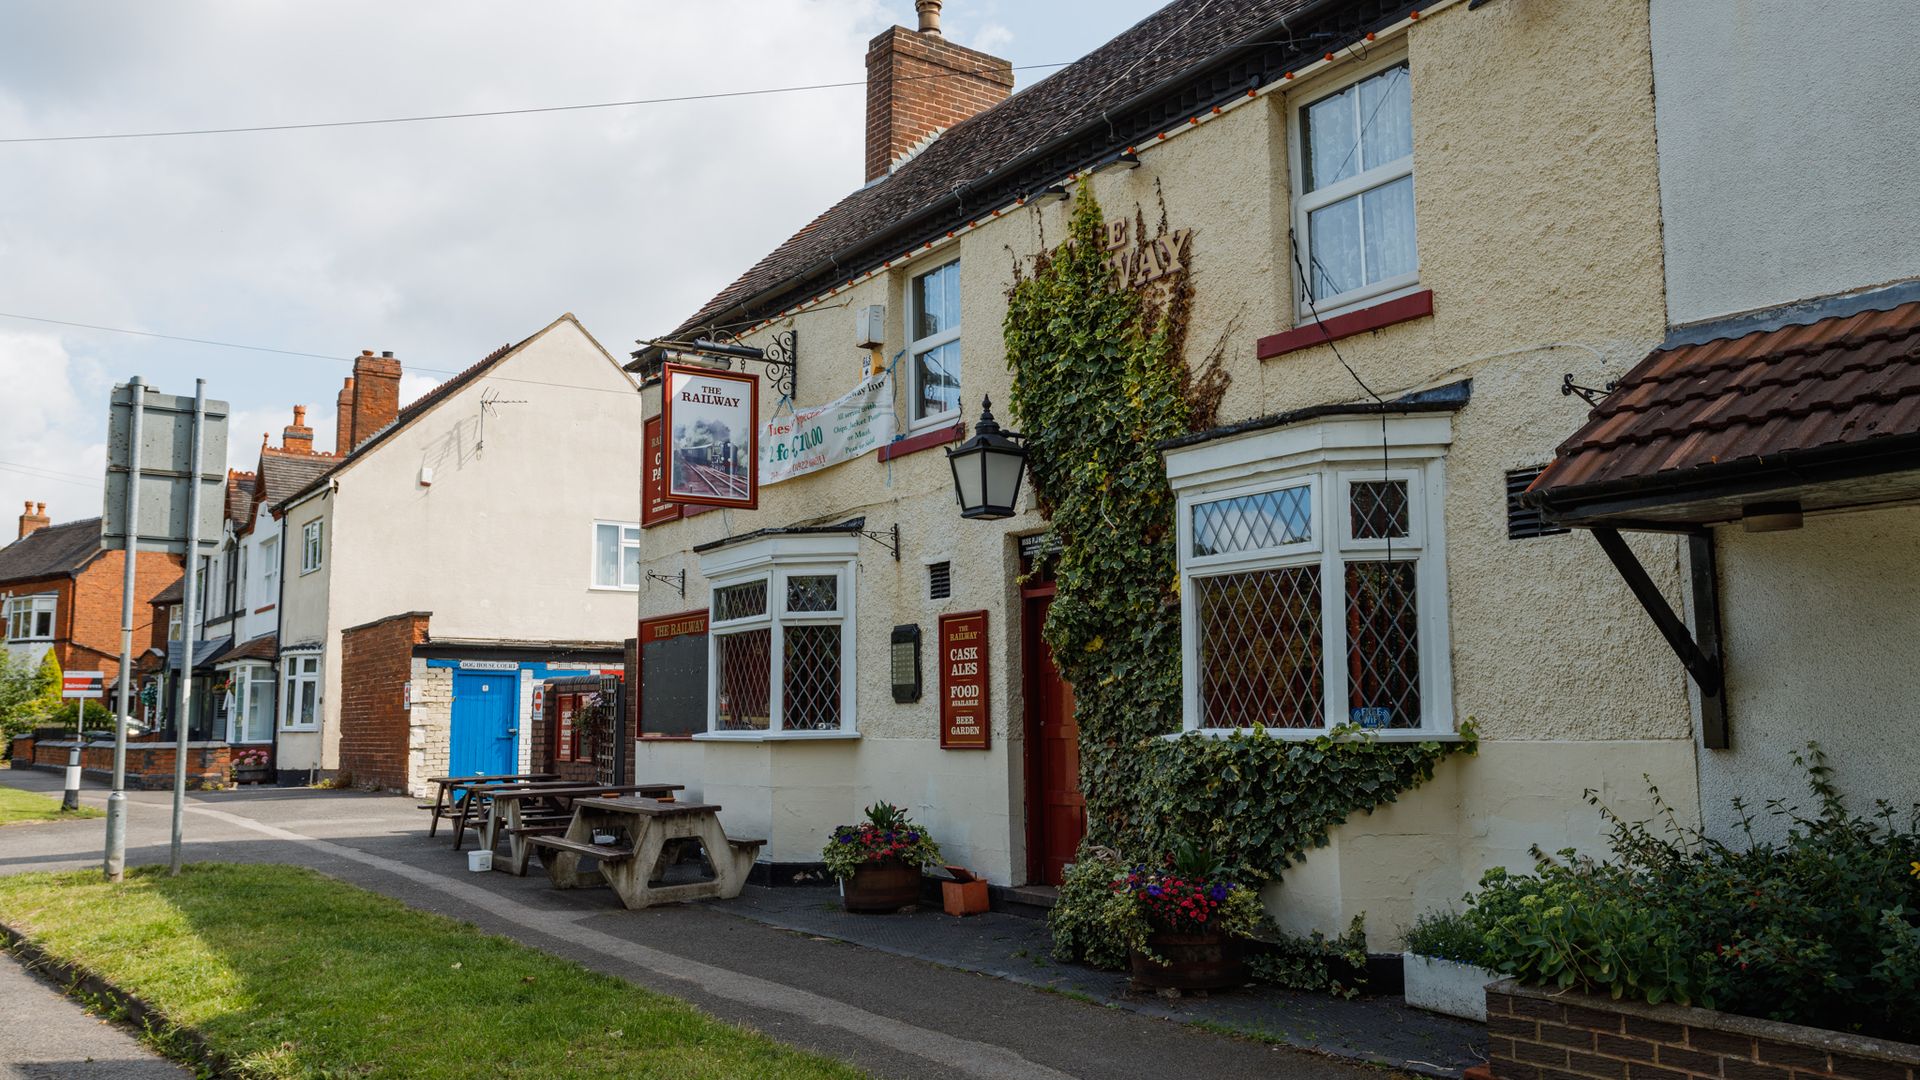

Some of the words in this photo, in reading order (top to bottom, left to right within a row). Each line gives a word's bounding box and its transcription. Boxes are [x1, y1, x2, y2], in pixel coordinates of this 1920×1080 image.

[701, 386, 722, 395] THE
[867, 380, 885, 393] Inn
[681, 391, 740, 408] RAILWAY
[654, 624, 669, 638] THE
[670, 619, 705, 635] RAILWAY
[950, 631, 977, 641] RAILWAY
[950, 647, 978, 661] CASK
[951, 662, 978, 676] ALES
[950, 685, 979, 698] FOOD
[952, 699, 979, 707] AVAILABLE
[1361, 707, 1381, 716] FREE
[956, 716, 975, 725] BEER
[951, 726, 980, 736] GARDEN
